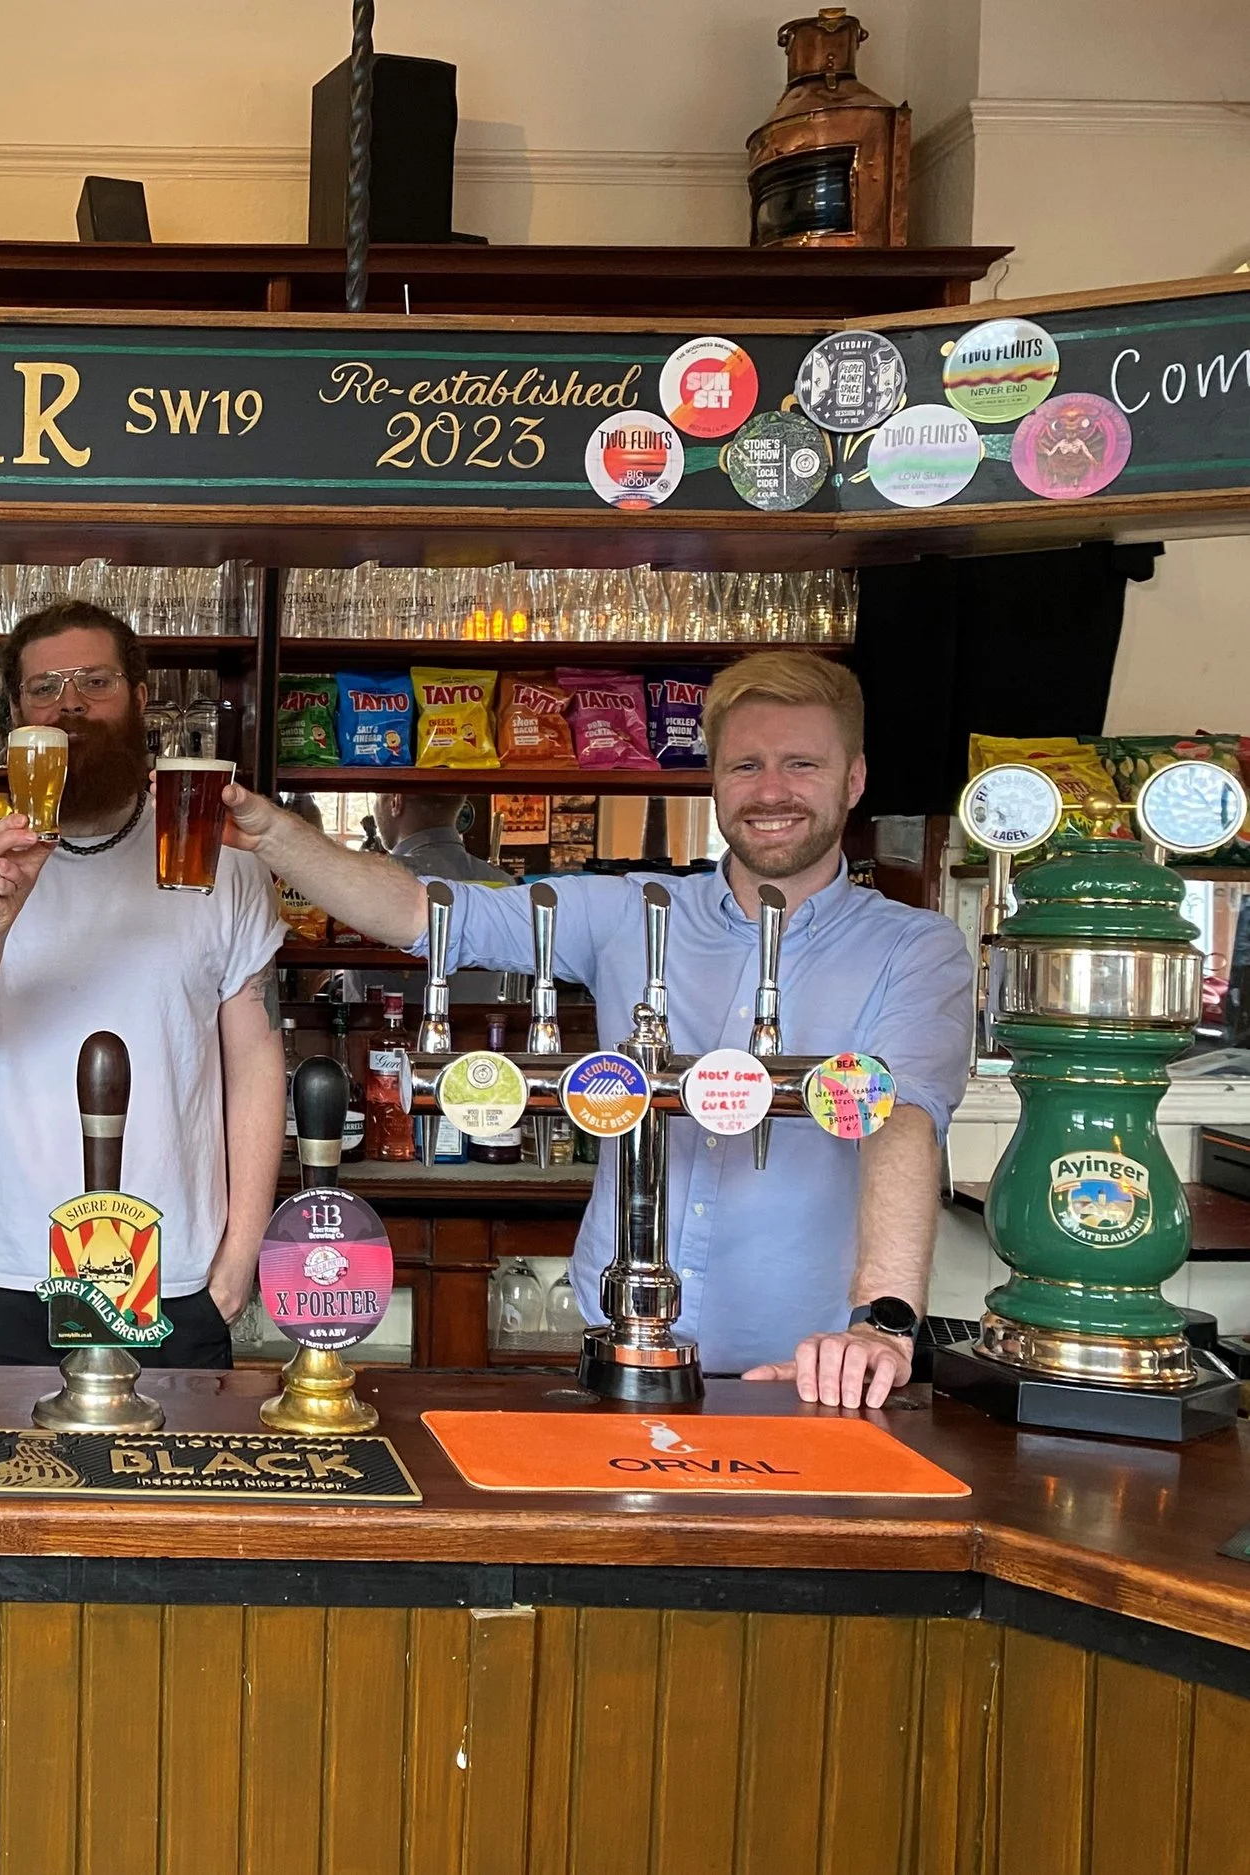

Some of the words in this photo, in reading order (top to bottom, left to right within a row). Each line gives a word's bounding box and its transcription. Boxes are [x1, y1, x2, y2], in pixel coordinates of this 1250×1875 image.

[834, 340, 872, 351] VERDANT
[961, 346, 991, 364] TWO
[996, 338, 1042, 360] FLINTS
[841, 364, 862, 373] PEOPLE
[319, 362, 642, 408] Re-established
[686, 371, 730, 391] SUN
[841, 375, 862, 383] MONEY
[840, 385, 860, 393] SPACE
[970, 386, 1003, 396] NEVER
[1006, 384, 1028, 394] END
[693, 390, 733, 409] SET
[841, 394, 860, 402] TIME
[126, 387, 263, 436] SW19
[376, 411, 545, 469] 2023
[599, 430, 626, 449] TWO
[630, 430, 672, 449] FLINTS
[883, 425, 913, 447] TWO
[919, 423, 967, 445] FLINTS
[743, 439, 780, 449] STONE'S
[749, 450, 780, 460] THROW
[626, 470, 643, 479] BIG
[756, 469, 778, 477] LOCAL
[898, 472, 921, 480] LOW
[922, 471, 946, 480] SUN
[619, 478, 651, 487] MOON
[757, 479, 778, 487] CIDER
[422, 684, 485, 705] TAYTO
[665, 680, 708, 704] TAYT
[349, 690, 409, 712] TAYTO
[513, 684, 565, 714] TAYTO
[576, 690, 635, 710] TAYTO
[428, 718, 456, 728] CHEESE
[512, 719, 538, 727] SMOKY
[665, 718, 696, 726] PICKLED
[356, 726, 372, 734] SALT
[513, 726, 539, 734] BACON
[666, 727, 692, 735] ONION
[353, 734, 382, 743] VINEGAR
[837, 1059, 862, 1068] BEAK
[578, 1057, 637, 1085] newbarns
[698, 1070, 729, 1080] HOLY
[734, 1071, 765, 1083] GOAT
[815, 1088, 849, 1098] WESTERN
[702, 1099, 746, 1111] CURSE
[579, 1108, 607, 1129] TABLE
[610, 1109, 636, 1128] BEER
[829, 1114, 860, 1125] BRIGHT
[864, 1112, 878, 1120] IPA
[343, 1122, 363, 1130] ARRELS
[1057, 1155, 1144, 1182] Ayinger
[66, 1200, 107, 1222] SHERE
[111, 1199, 146, 1221] DROP
[309, 1232, 335, 1240] Brewing
[276, 1292, 290, 1316] X
[296, 1290, 380, 1317] PORTER
[35, 1279, 89, 1299] SURREY
[86, 1287, 117, 1323] HILLS
[111, 1317, 169, 1342] BREWERY
[328, 1328, 347, 1336] ABV
[305, 1340, 324, 1350] TASTE
[332, 1337, 358, 1350] HISTORY
[174, 1434, 283, 1450] LONDON
[110, 1449, 364, 1479] BLACK
[608, 1457, 800, 1476] ORVAL
